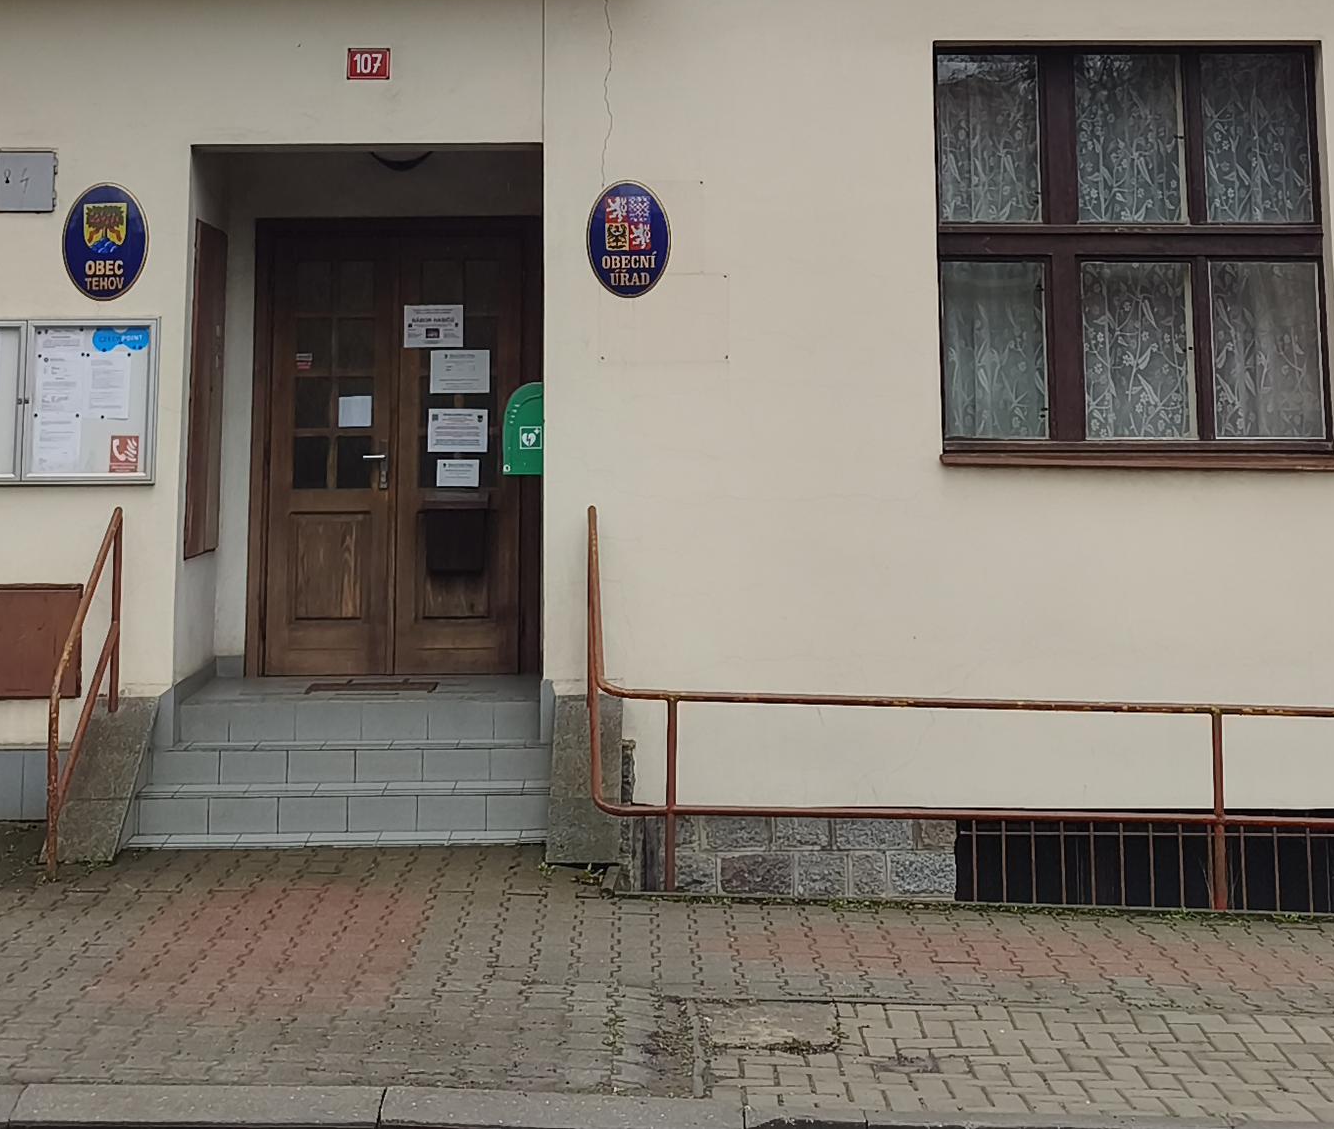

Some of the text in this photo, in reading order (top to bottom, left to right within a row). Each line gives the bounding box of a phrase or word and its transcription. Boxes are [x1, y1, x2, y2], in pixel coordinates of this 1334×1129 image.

[353, 53, 383, 74] 107
[85, 260, 124, 275] OBEC
[601, 251, 657, 269] OBECNÍ
[84, 276, 124, 290] TEHOV
[610, 269, 651, 286] ÚŘAD
[268, 596, 300, 610] HUP
